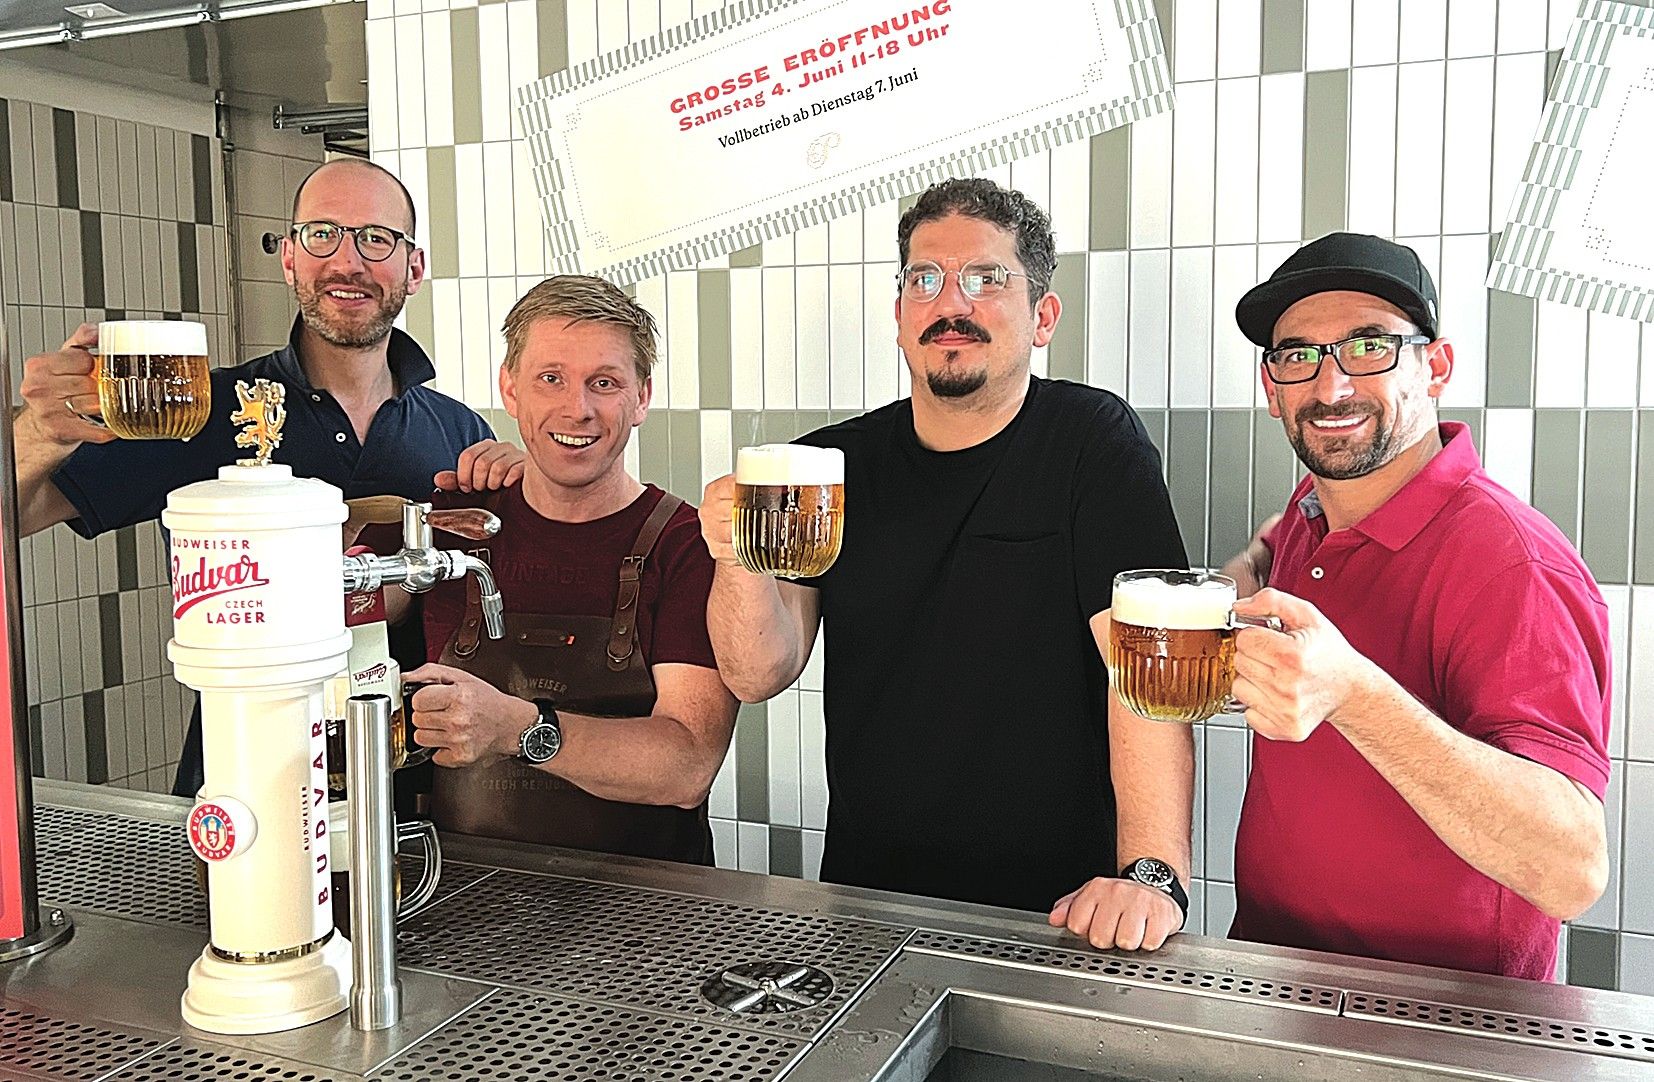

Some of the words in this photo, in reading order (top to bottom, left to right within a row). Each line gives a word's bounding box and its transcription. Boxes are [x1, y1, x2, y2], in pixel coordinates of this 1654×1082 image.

[670, 66, 770, 114] GROSSE
[783, 0, 952, 72] ERÖFFNUNG
[678, 91, 766, 132] Samstag
[771, 83, 791, 97] 4.
[799, 59, 844, 88] Juni
[851, 41, 900, 68] 11-18
[907, 23, 950, 47] Uhr
[717, 113, 791, 149] Vollbetrieb
[793, 108, 809, 123] ab
[811, 84, 875, 117] Dienstag
[877, 80, 888, 93] 7.
[889, 67, 919, 91] Juni
[172, 554, 269, 619] Budvar
[225, 600, 263, 608] CZECH
[206, 611, 265, 624] LAGER
[507, 678, 568, 695] BUDWEISER
[192, 806, 235, 836] BUDWEISER
[311, 718, 329, 905] BUDVAR
[196, 841, 231, 859] BUDVAR
